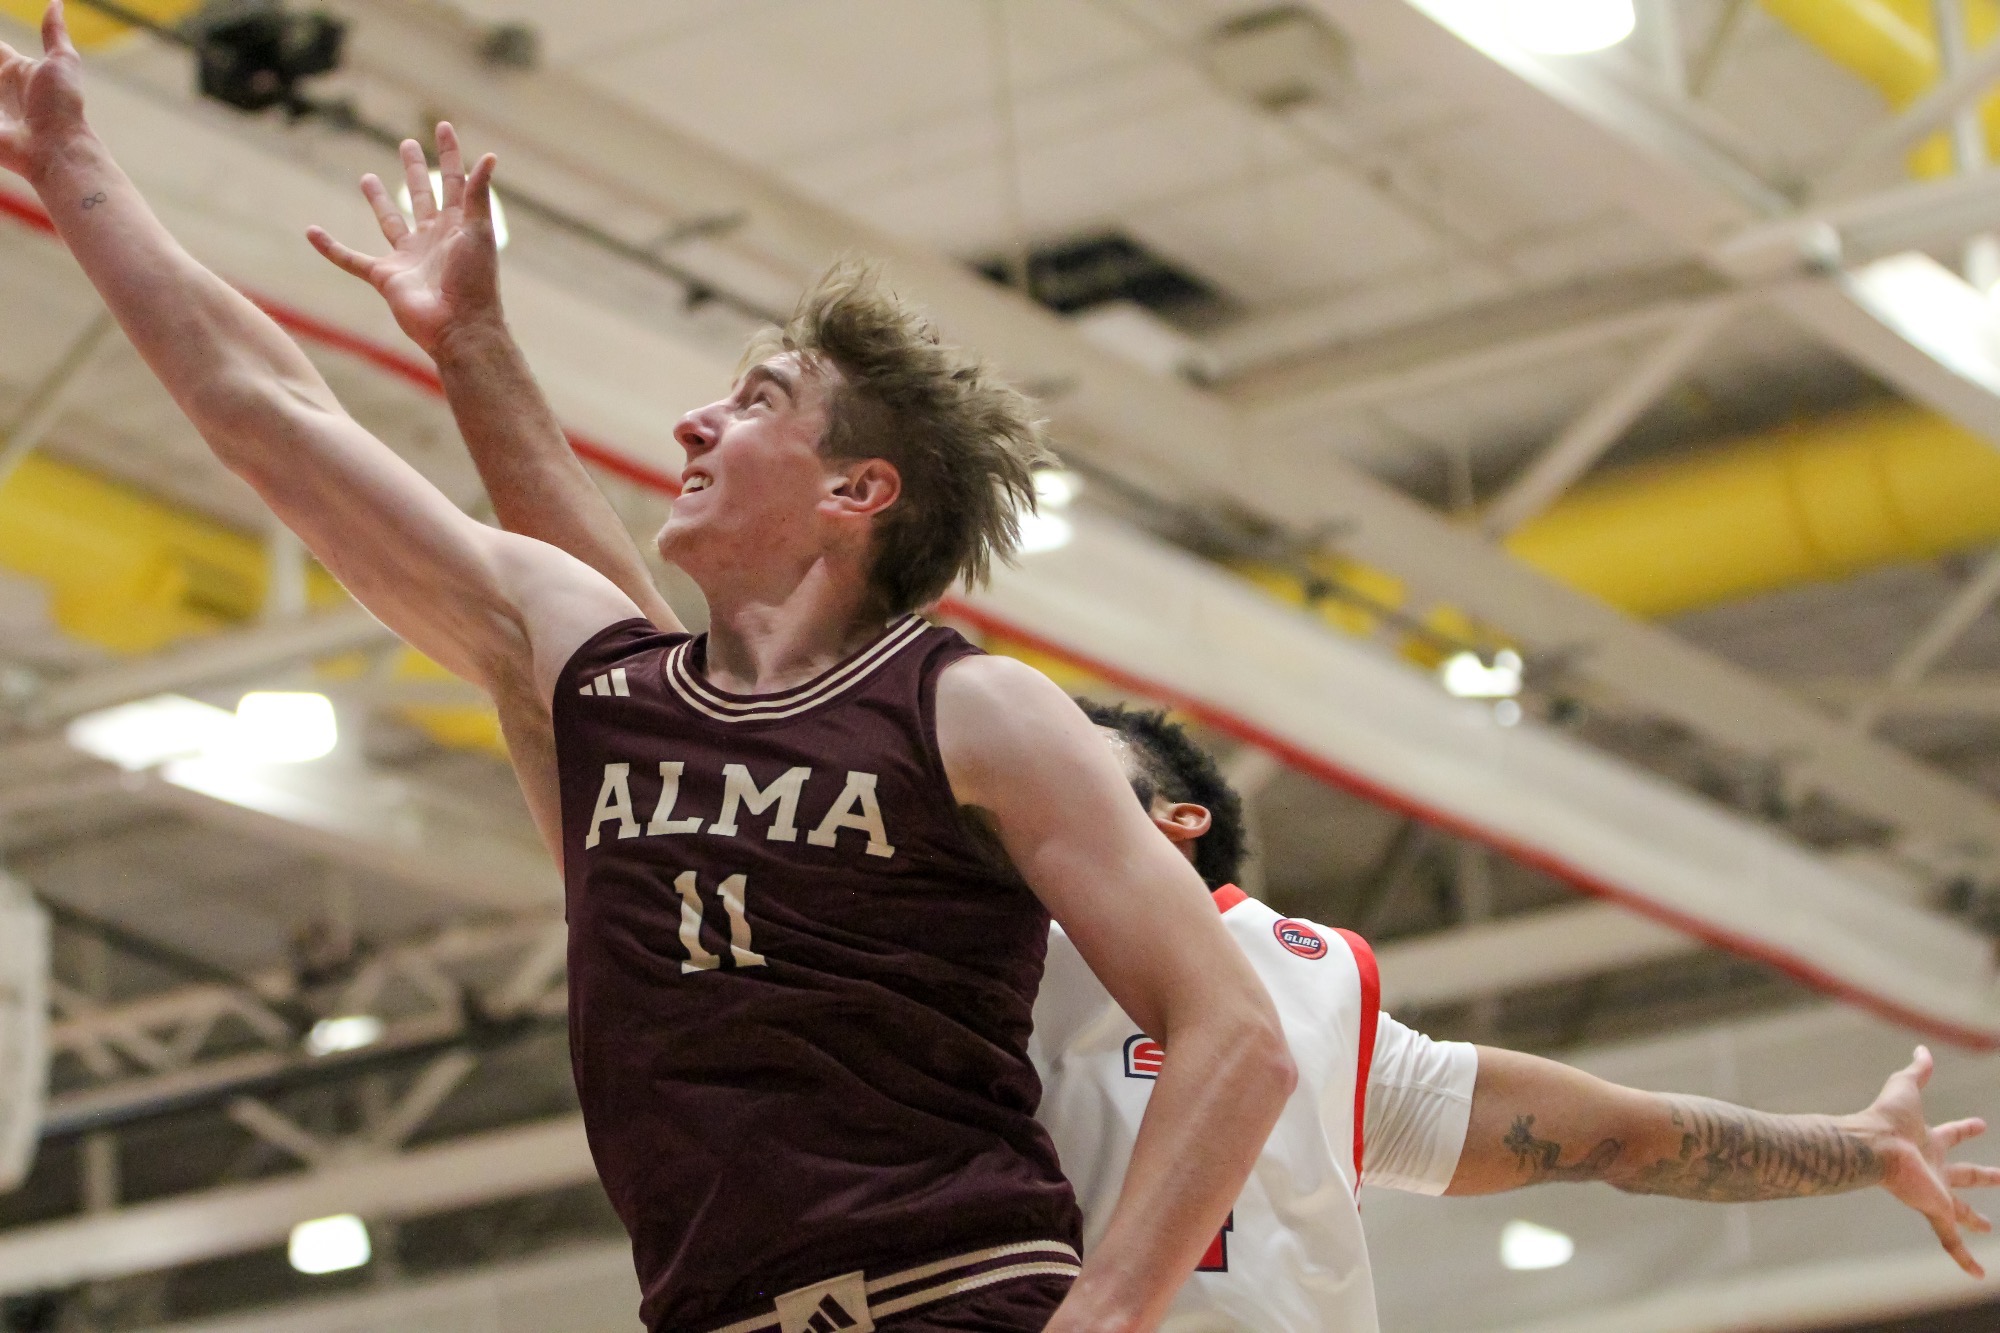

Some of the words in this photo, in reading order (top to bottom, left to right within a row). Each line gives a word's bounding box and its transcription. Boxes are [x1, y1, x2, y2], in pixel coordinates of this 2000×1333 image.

[585, 761, 895, 858] ALMA
[673, 870, 769, 974] 11
[1284, 933, 1320, 948] GLIAC
